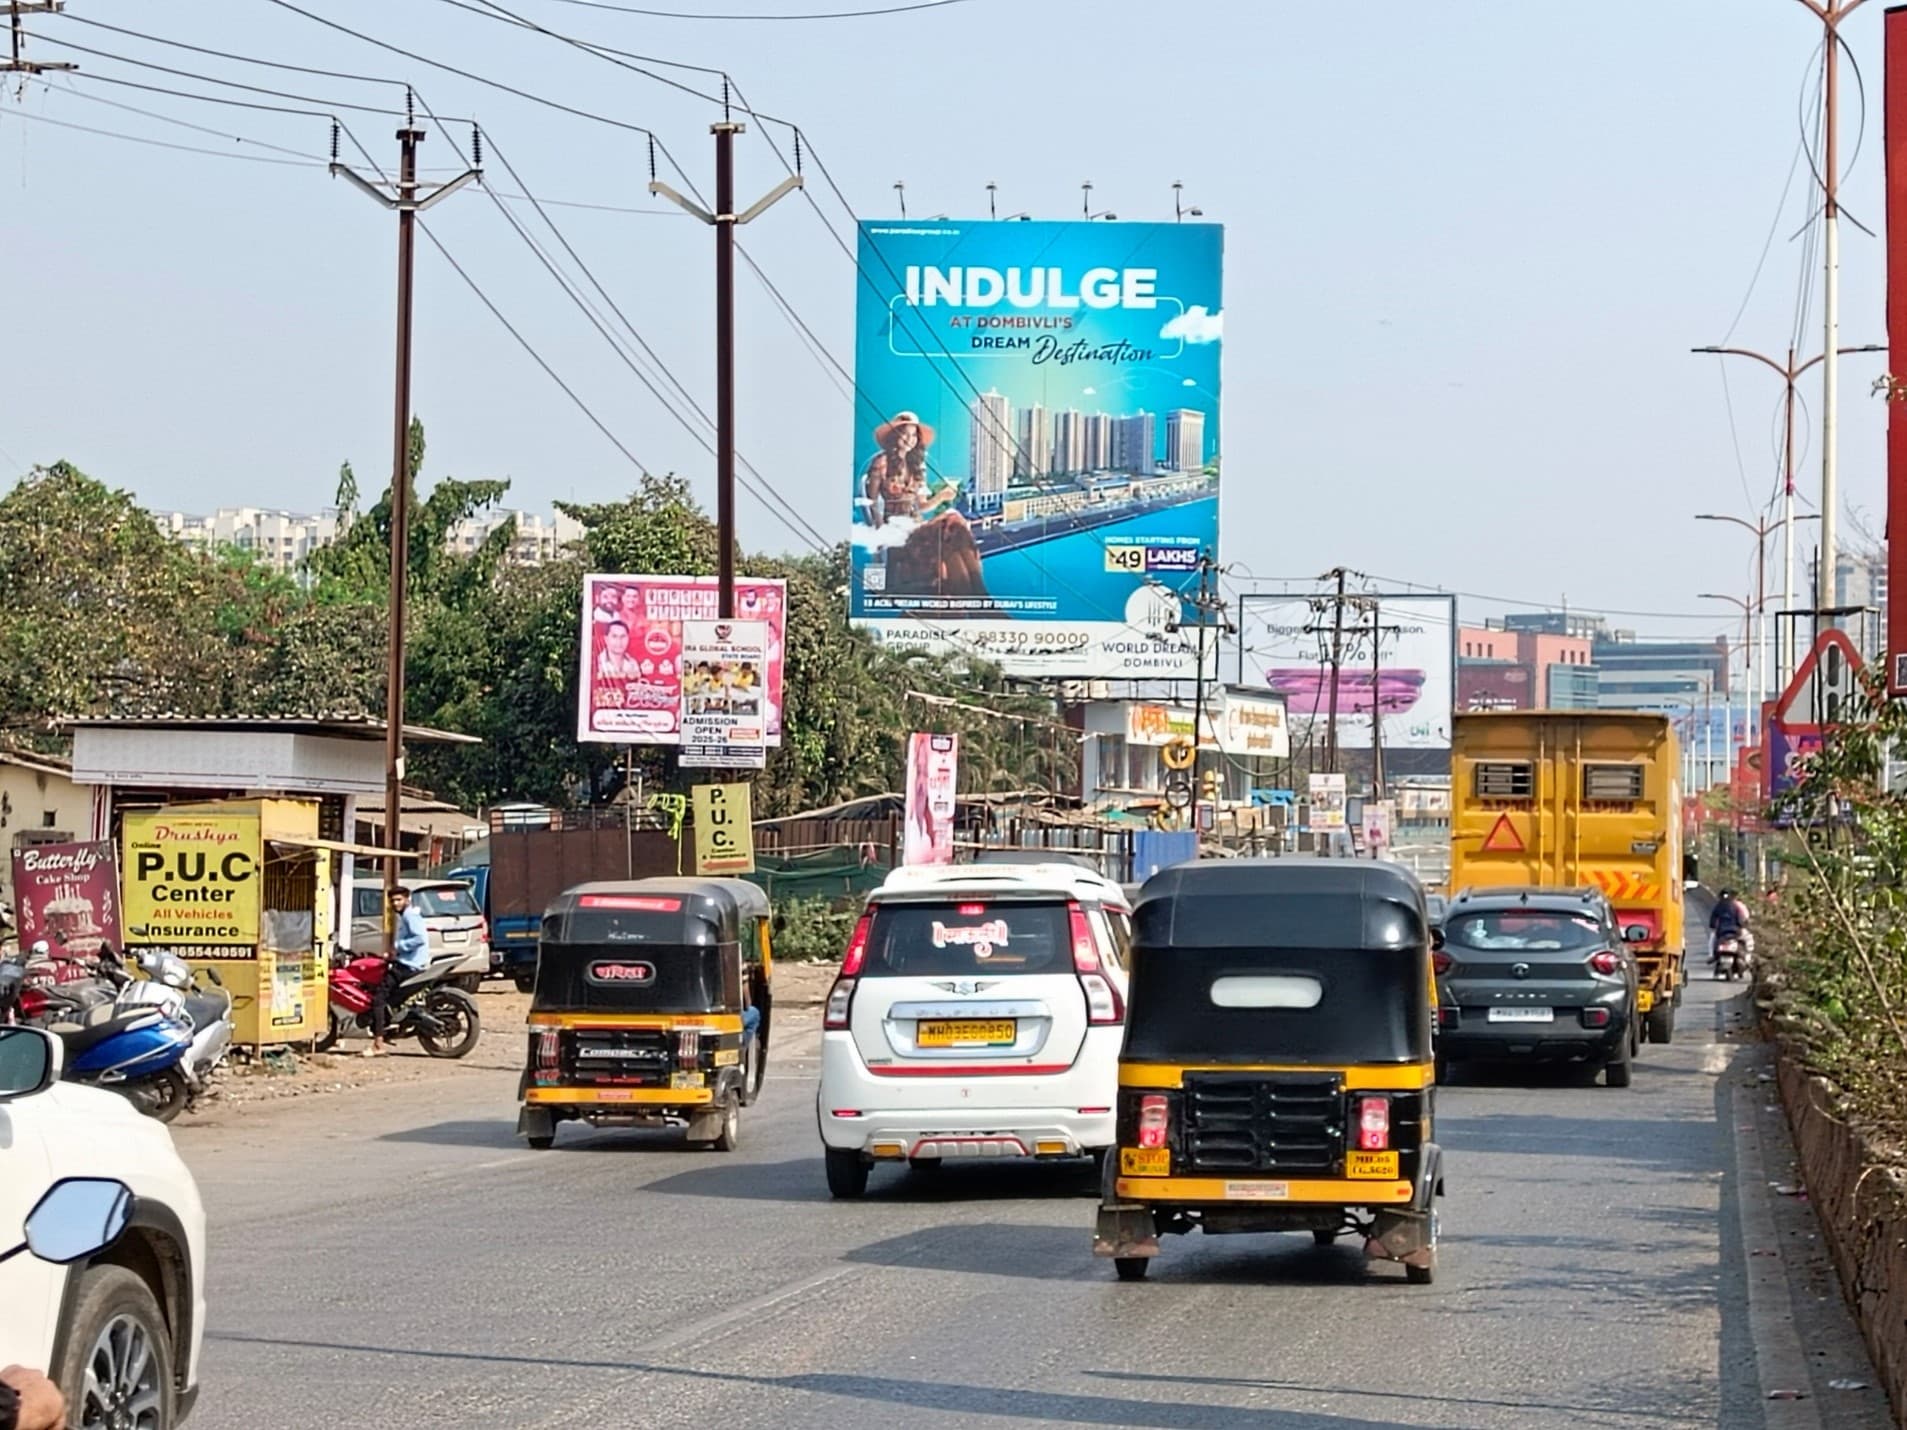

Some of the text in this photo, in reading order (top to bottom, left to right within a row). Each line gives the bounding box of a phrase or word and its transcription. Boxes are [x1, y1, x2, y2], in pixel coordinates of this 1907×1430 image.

[905, 265, 1158, 309] INDULGE
[950, 316, 1073, 329] AT DOMBIVLI'S
[970, 334, 1153, 366] DREAM Destination
[1148, 548, 1197, 563] LAKHS
[1033, 632, 1090, 645] 90000
[1102, 642, 1149, 654] WORLD
[1123, 658, 1183, 667] DOMBIVLI
[683, 717, 738, 725] ADMISSION
[694, 726, 722, 734] OPEN
[691, 735, 728, 743] 2025-26
[153, 826, 241, 846] Drushya
[23, 848, 98, 873] Butterfly
[137, 851, 252, 882] P.U.C
[35, 872, 91, 885] Cake Shop
[151, 884, 235, 903] Center
[152, 908, 234, 920] All Vehicles
[144, 922, 240, 937] Insurance
